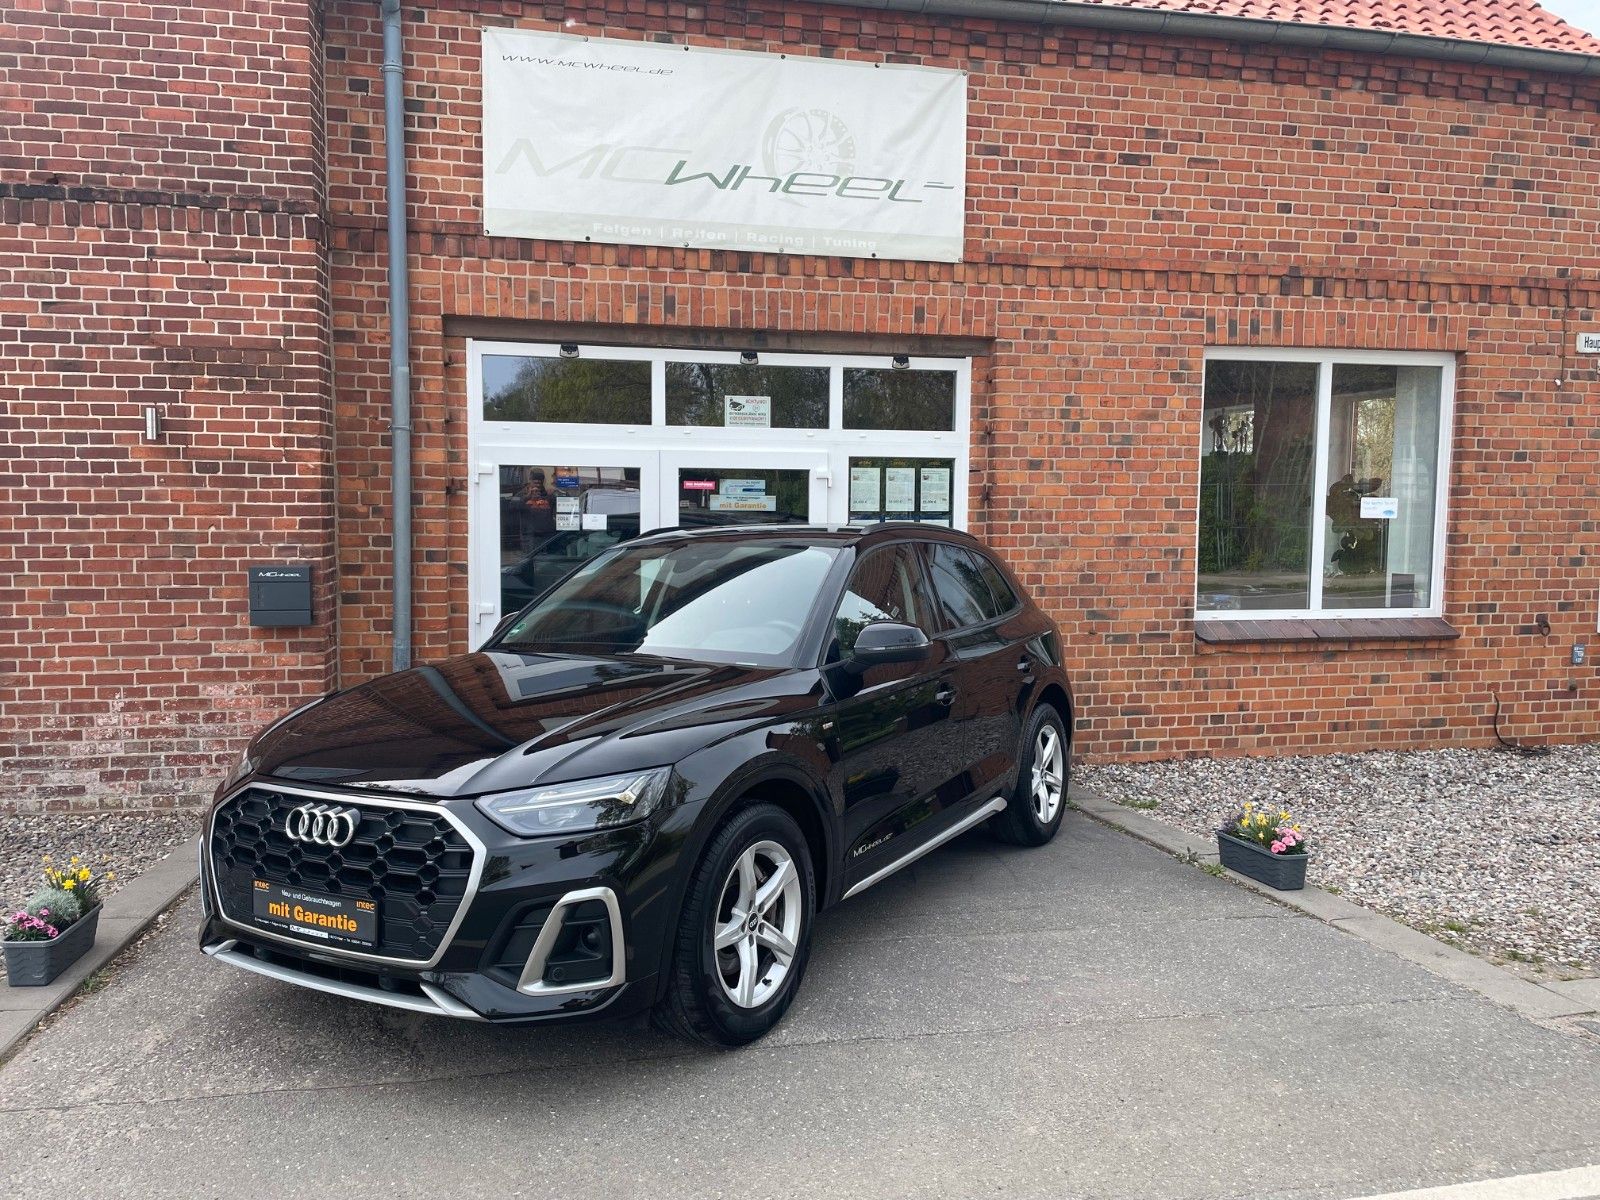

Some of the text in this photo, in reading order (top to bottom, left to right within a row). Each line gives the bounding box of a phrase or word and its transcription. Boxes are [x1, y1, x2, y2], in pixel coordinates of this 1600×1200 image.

[592, 222, 877, 250] Felgen Reifen Racing Tuning
[734, 502, 767, 510] Garantie
[268, 901, 290, 919] mit
[293, 905, 357, 931] Garantie
